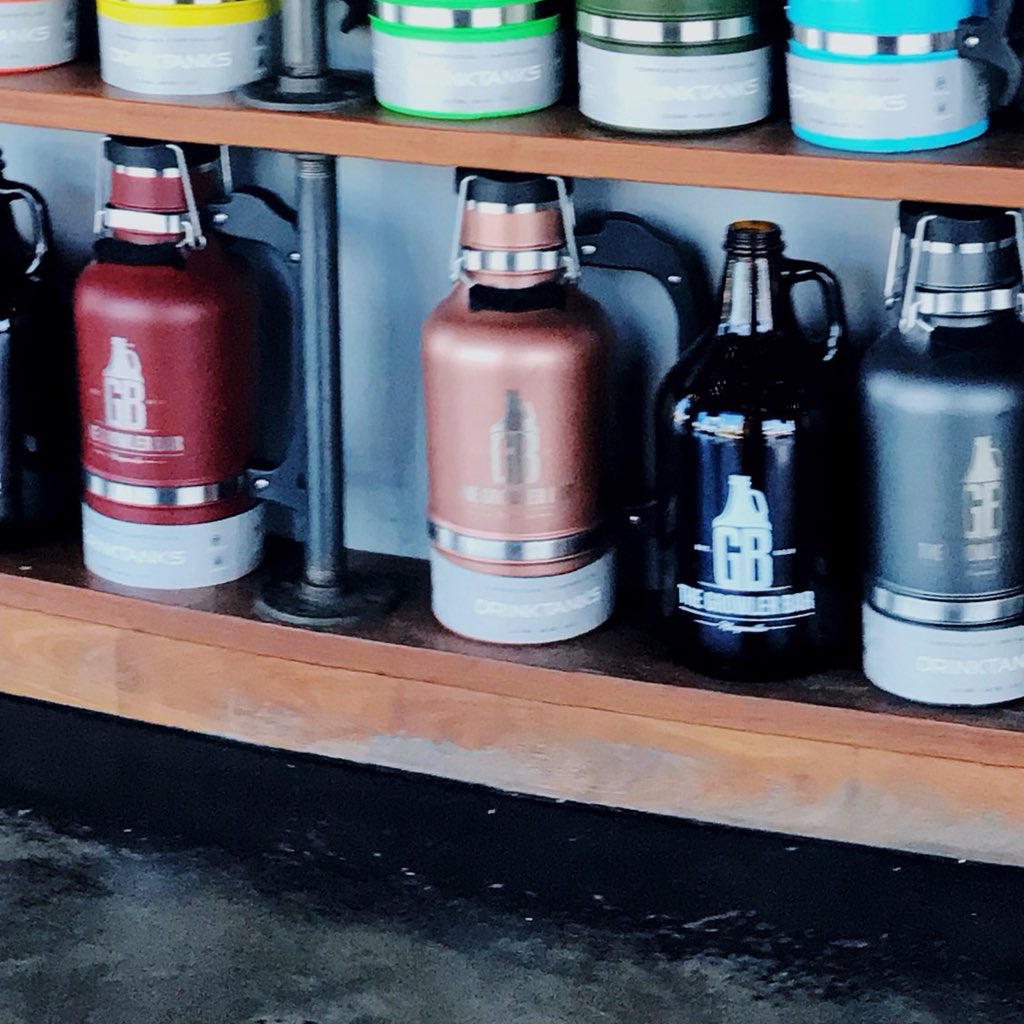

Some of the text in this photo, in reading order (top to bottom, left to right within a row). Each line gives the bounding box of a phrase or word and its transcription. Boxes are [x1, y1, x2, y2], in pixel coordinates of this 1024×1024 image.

[104, 378, 148, 430] GB
[712, 526, 773, 589] GB
[475, 586, 602, 618] DRINKTANKS
[677, 583, 816, 617] THE GROWLER BAR
